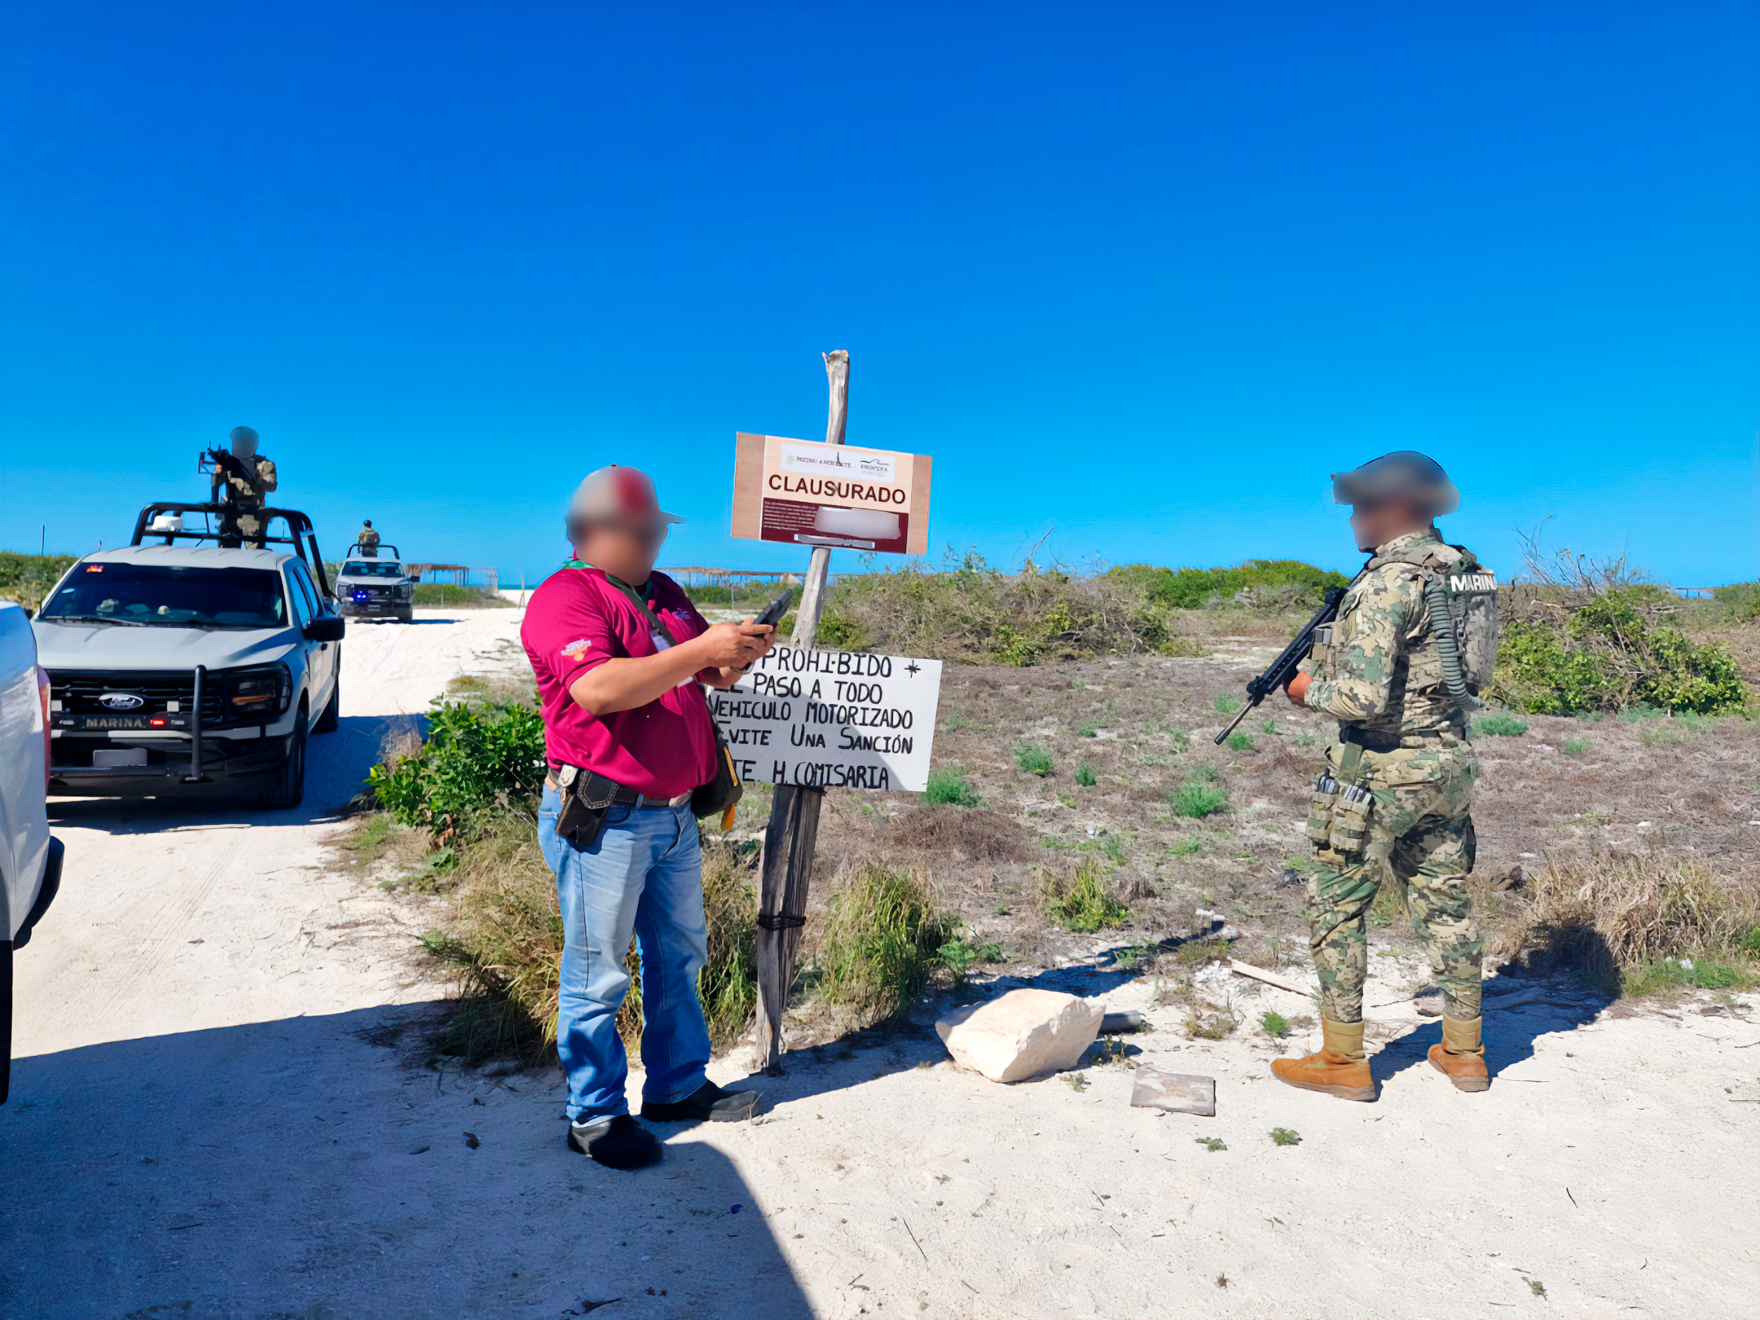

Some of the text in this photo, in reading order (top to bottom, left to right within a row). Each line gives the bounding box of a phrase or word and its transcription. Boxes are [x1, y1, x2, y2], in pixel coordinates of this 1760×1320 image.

[768, 474, 906, 505] CLAUSURADO
[761, 646, 892, 678] PROHIBIDO
[753, 672, 801, 699] PASO
[809, 679, 822, 699] A
[834, 680, 883, 704] TODO
[86, 718, 143, 728] MARINA
[708, 694, 913, 729] VEHICULO MOTORIZADO
[838, 727, 913, 754] SANCIÓN
[794, 761, 889, 790] COMISARIA
